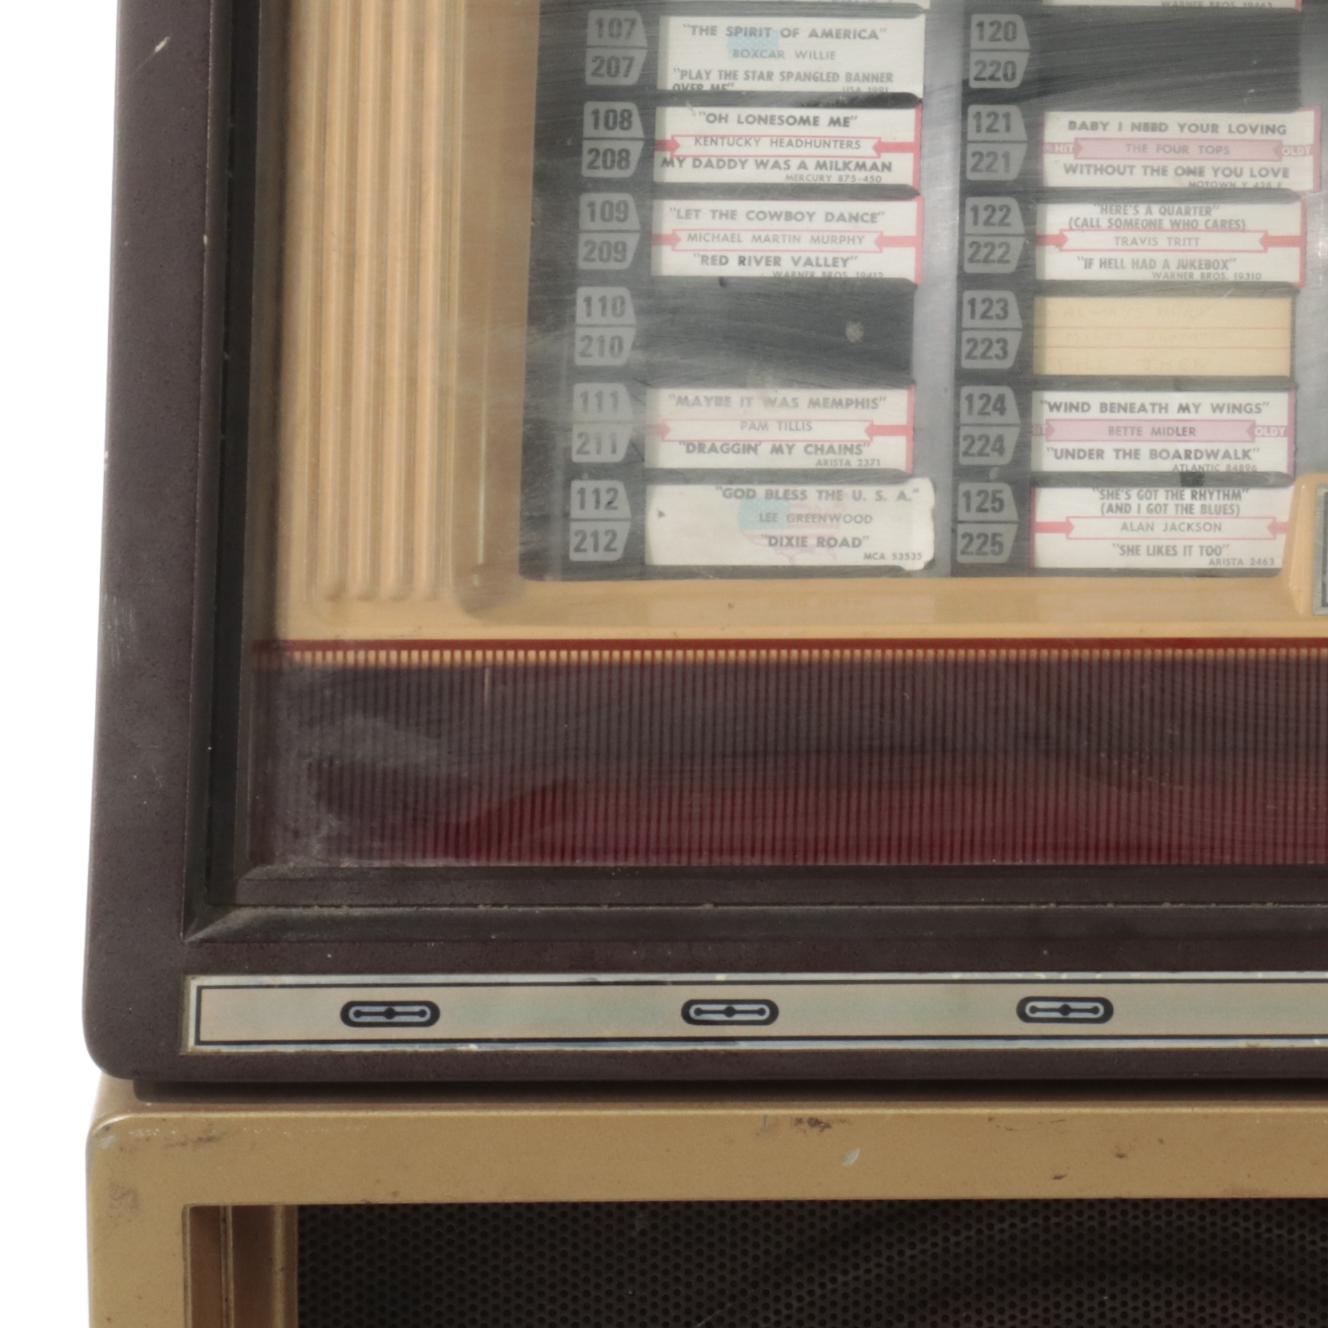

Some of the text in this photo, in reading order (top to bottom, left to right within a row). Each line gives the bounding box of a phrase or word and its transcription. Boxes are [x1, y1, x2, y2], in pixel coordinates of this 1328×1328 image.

[589, 109, 633, 130] 108
[698, 112, 858, 127] "OH LONESOME ME"
[694, 137, 861, 149] KENTUCKY HEADHUNTERS
[587, 148, 630, 170] 208
[662, 157, 892, 172] MY DADDY WAS A MILKMAN
[1064, 164, 1289, 180] WITHOUT THE ONE YOU LOVE
[669, 207, 885, 224] "LET THE COWBOY DANCE"
[963, 394, 1007, 416] 124
[1041, 400, 1270, 415] "WIND BENEATH MY WINGS"
[740, 420, 813, 432] PAM TILLIS
[1108, 426, 1197, 437] BETTE MIDLER
[770, 443, 795, 455] MY
[803, 442, 871, 456] CHAINS"
[962, 436, 1005, 457] 224
[577, 489, 619, 510] 112
[574, 530, 617, 552] 212
[759, 533, 869, 549] "DIXIE ROAD"
[960, 533, 1002, 556] 225
